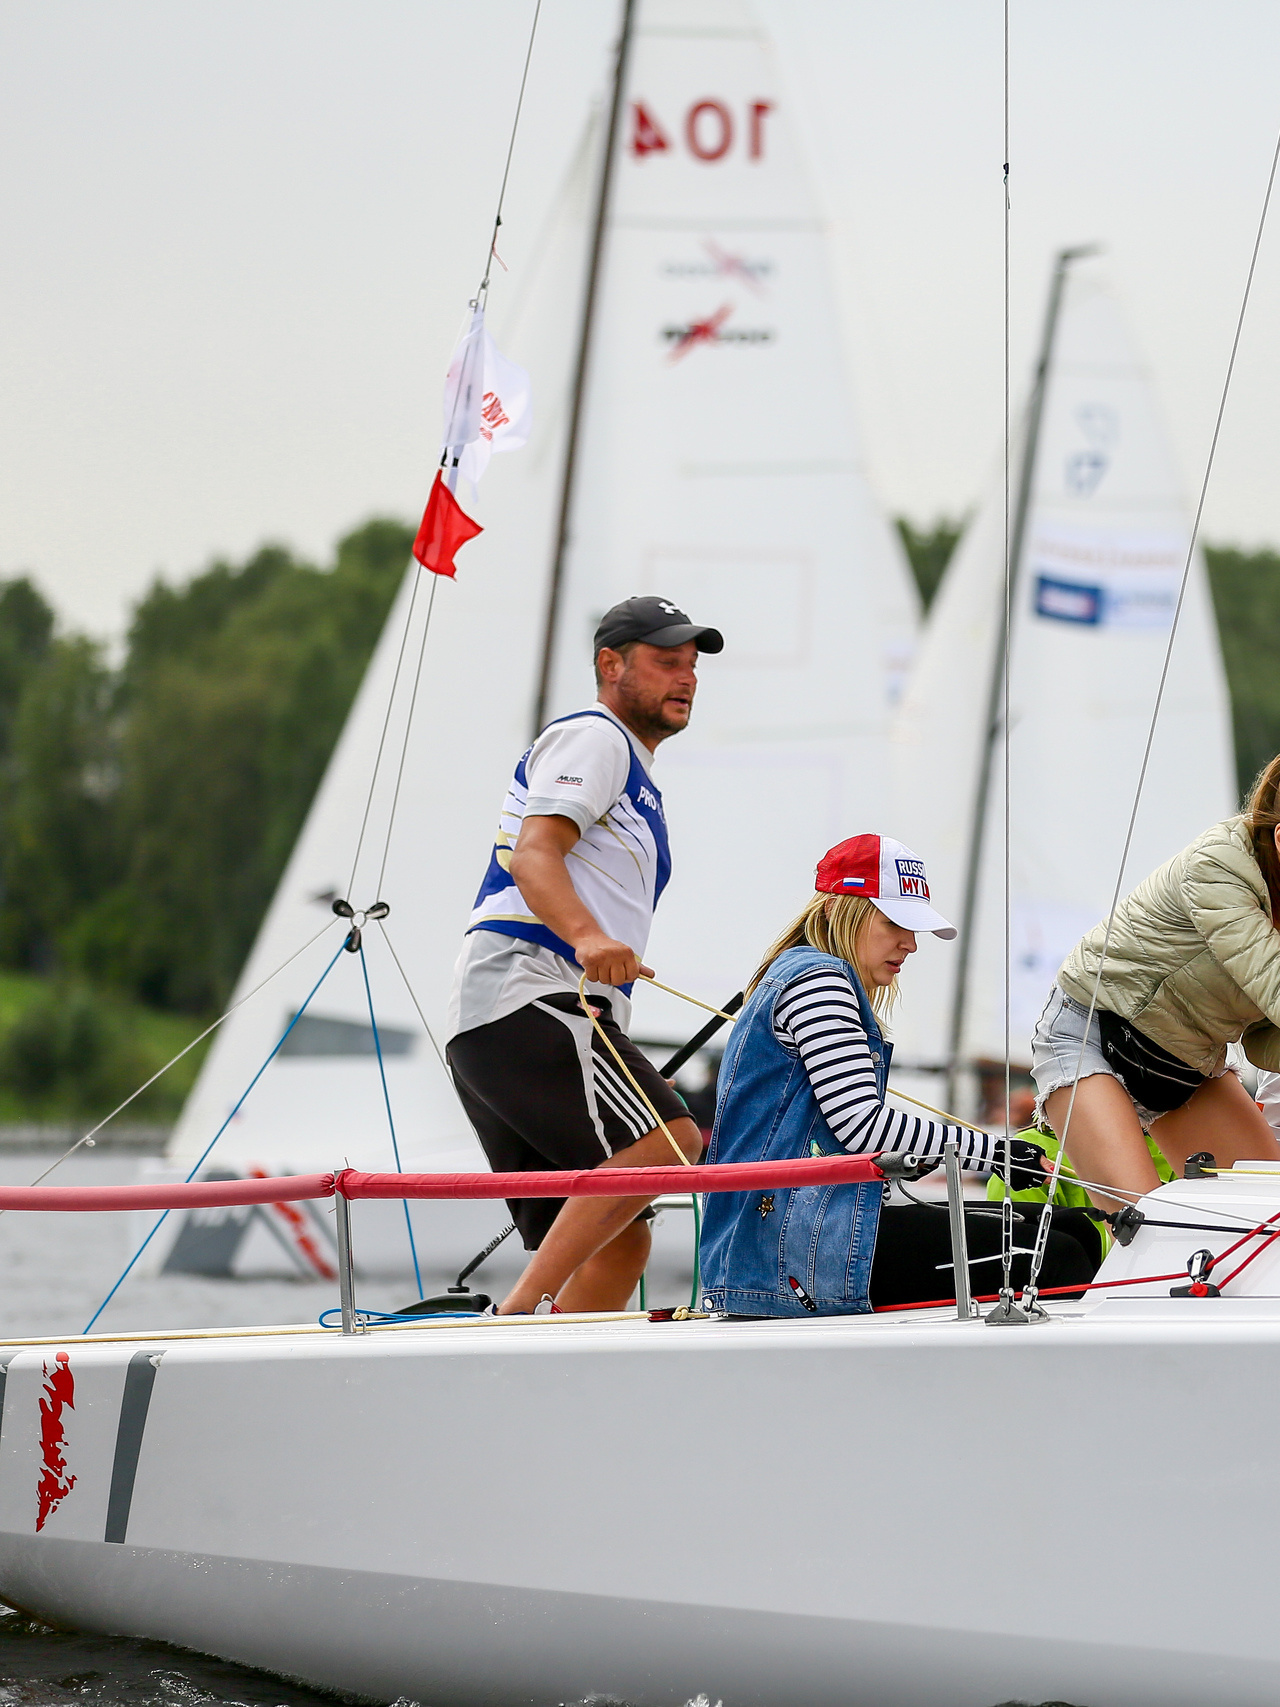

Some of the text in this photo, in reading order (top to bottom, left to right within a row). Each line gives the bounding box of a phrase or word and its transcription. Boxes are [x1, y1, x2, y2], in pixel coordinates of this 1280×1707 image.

[556, 774, 583, 784] MUSTO
[636, 785, 657, 811] PRO
[902, 877, 919, 895] MY
